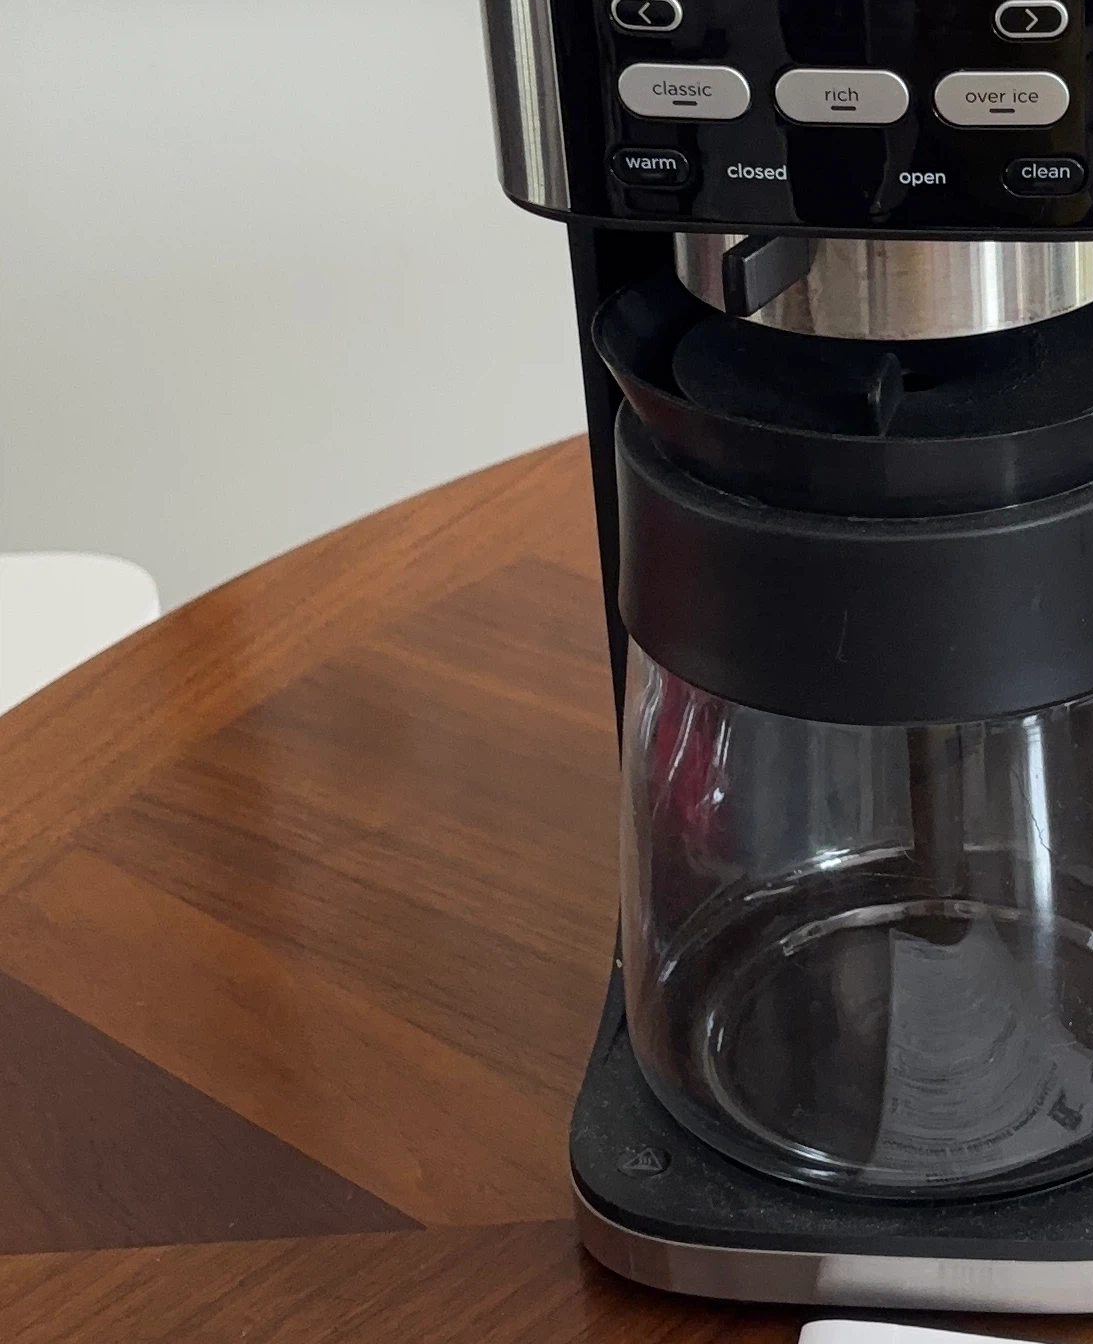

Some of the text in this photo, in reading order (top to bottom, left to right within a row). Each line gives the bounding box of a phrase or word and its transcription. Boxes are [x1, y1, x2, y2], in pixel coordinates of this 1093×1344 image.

[652, 80, 712, 98] classic
[825, 86, 859, 103] rich
[965, 89, 1039, 104] over ice
[626, 157, 676, 170] warm
[1021, 164, 1070, 179] clean
[727, 164, 787, 181] closed
[899, 170, 946, 187] open
